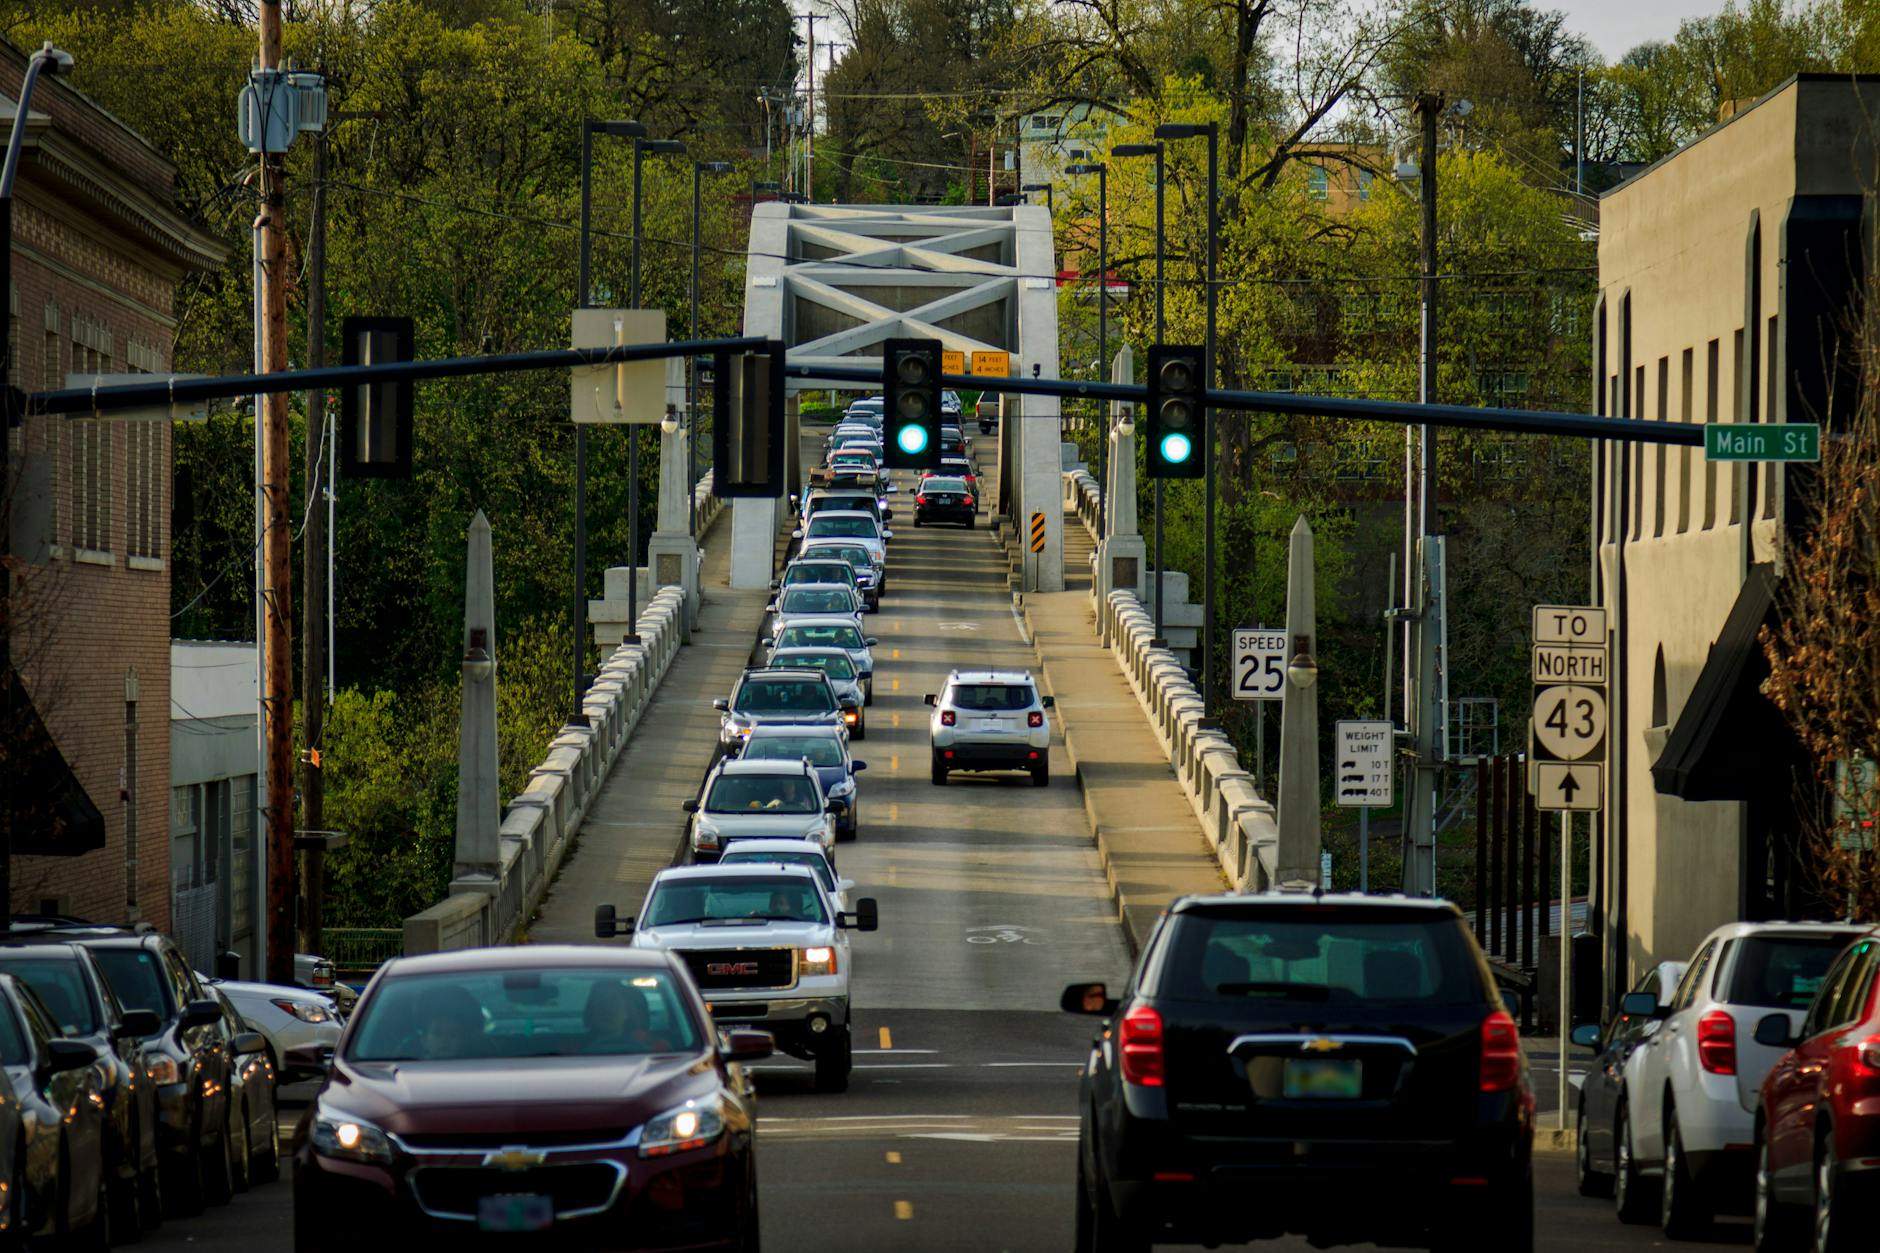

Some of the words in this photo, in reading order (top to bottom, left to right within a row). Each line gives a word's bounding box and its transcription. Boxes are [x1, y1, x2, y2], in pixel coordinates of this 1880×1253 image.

[1717, 431, 1765, 453] Main
[1784, 431, 1808, 454] St
[1553, 615, 1587, 636] TO
[1239, 636, 1285, 650] SPEED
[1538, 652, 1603, 677] NORTH
[1239, 655, 1284, 692] 25
[1545, 698, 1595, 739] 43
[1345, 731, 1385, 741] WEIGHT
[1350, 745, 1379, 753] LIMIT
[1371, 761, 1381, 769] 10
[1370, 789, 1382, 797] 40
[707, 962, 758, 976] GMC
